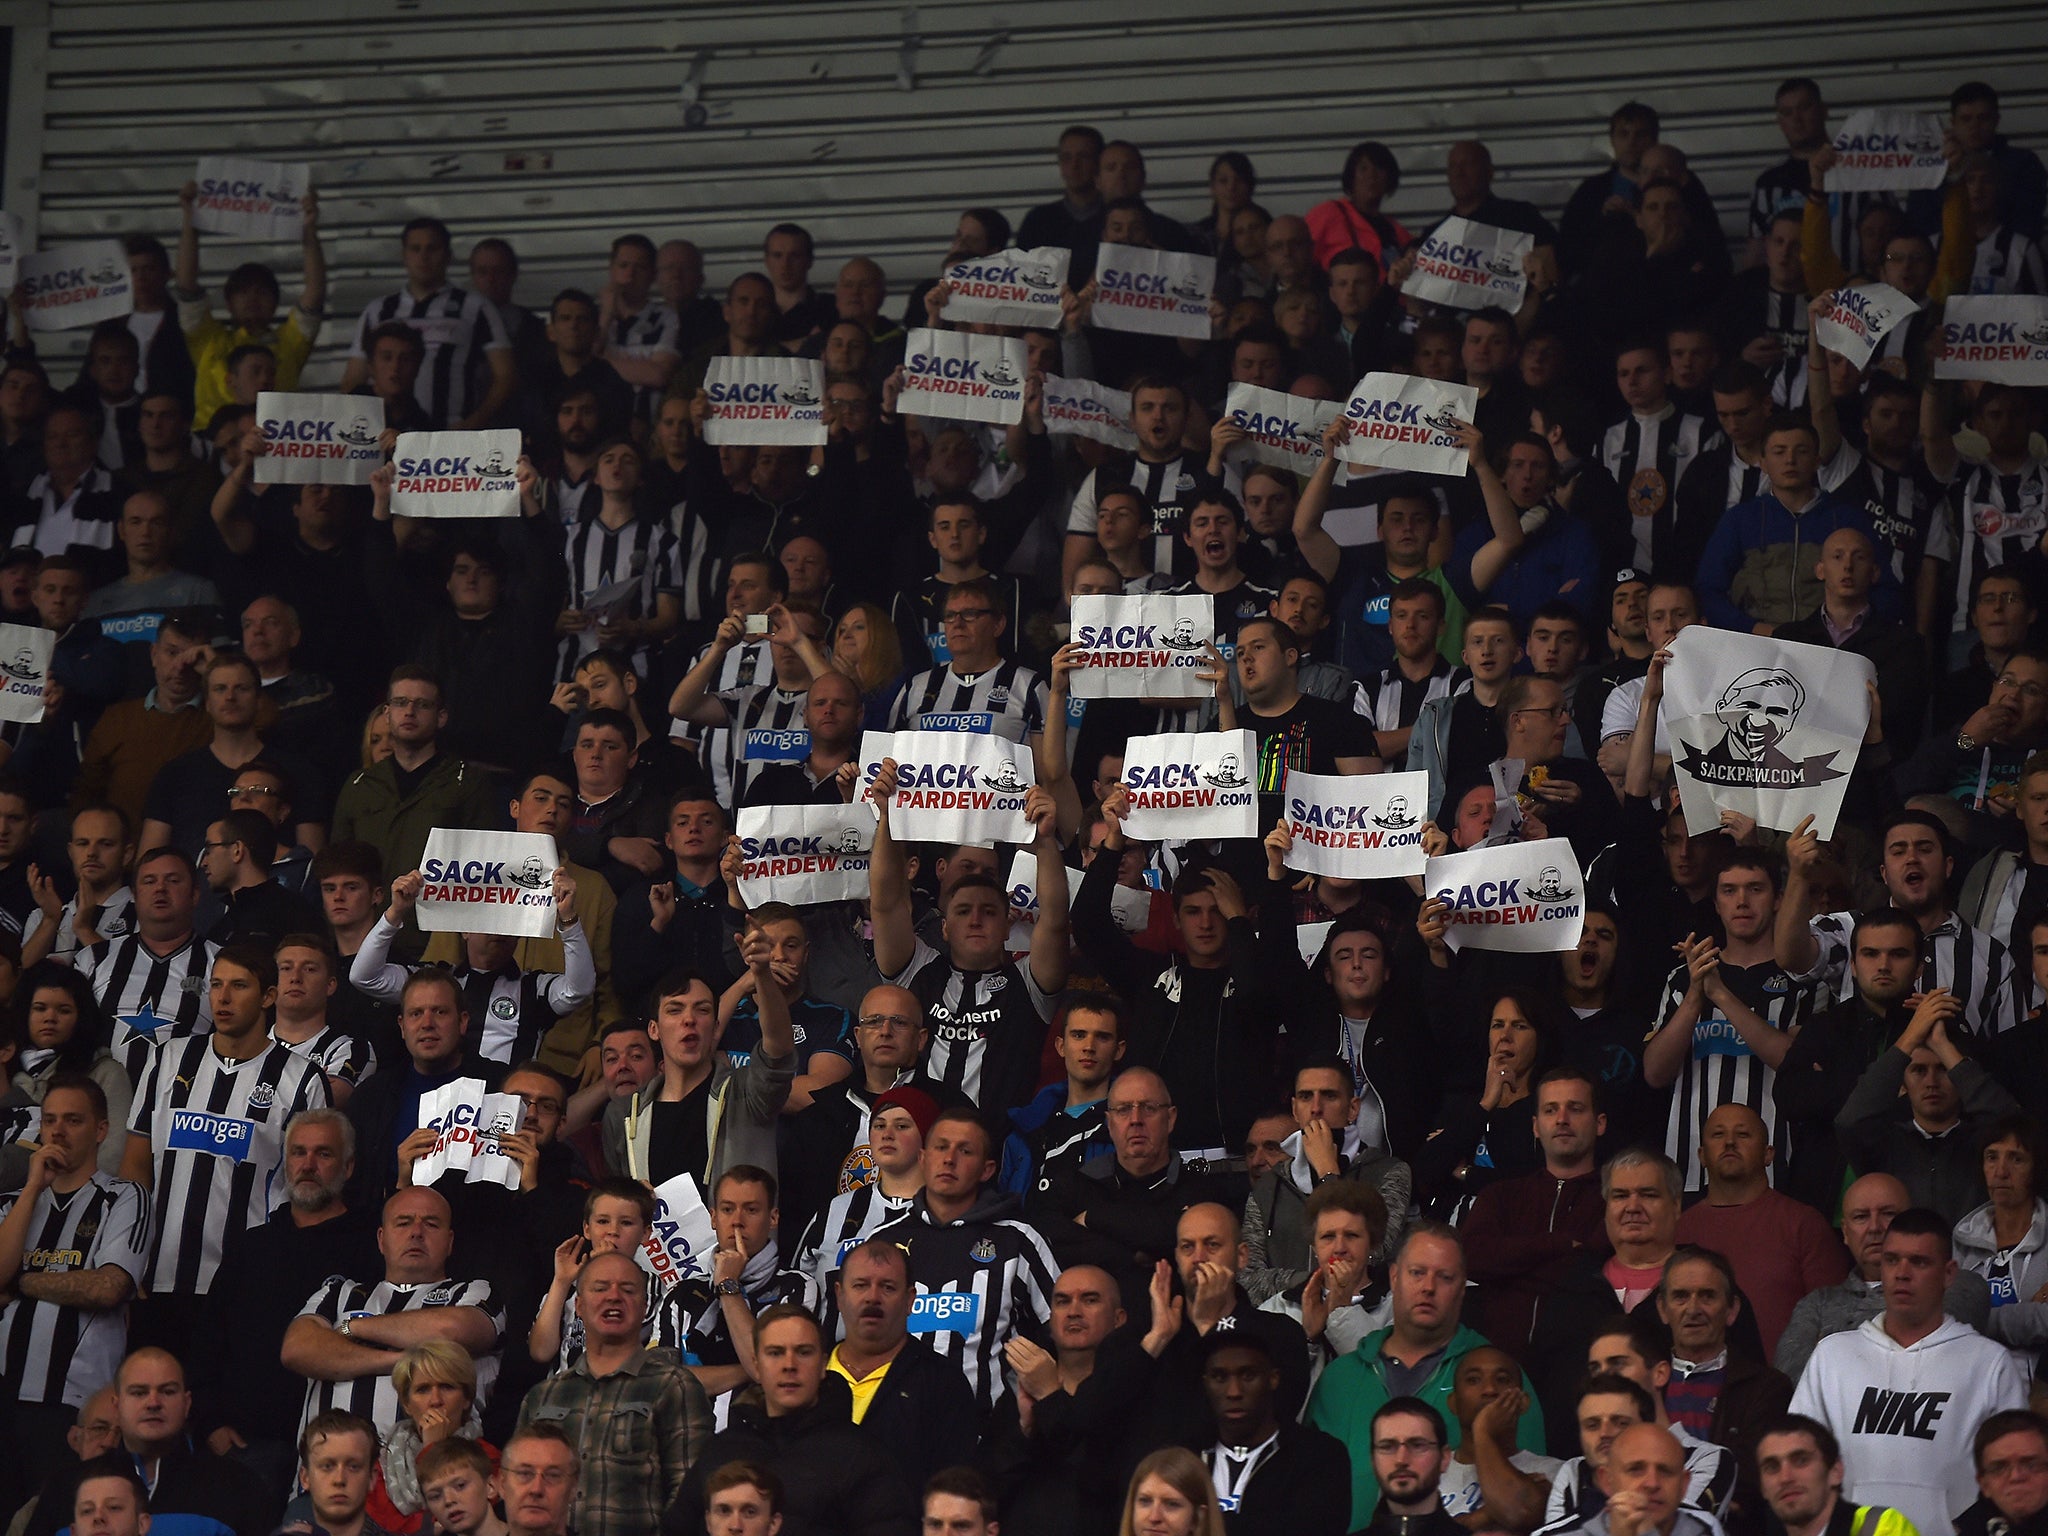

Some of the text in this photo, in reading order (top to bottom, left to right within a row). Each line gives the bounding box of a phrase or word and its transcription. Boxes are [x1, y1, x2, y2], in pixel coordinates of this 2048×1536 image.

[1834, 134, 1898, 152] SACK
[201, 178, 263, 199] SACK
[1421, 238, 1482, 268] SACK
[24, 267, 85, 296] SACK
[949, 264, 1019, 284] SACK
[1101, 269, 1167, 293] SACK
[1944, 322, 2018, 344] SACK
[908, 353, 979, 380] SACK
[710, 383, 779, 403] SACK
[1347, 398, 1423, 425] SACK
[263, 420, 334, 441] SACK
[1232, 409, 1300, 440] SACK
[398, 457, 471, 477] SACK
[1079, 624, 1157, 649] SACK
[920, 714, 982, 731] wonga
[748, 730, 803, 750] wonga
[896, 763, 979, 789] SACK
[1125, 763, 1201, 789] SACK
[1290, 797, 1370, 830] SACK
[741, 835, 823, 860] SACK
[423, 858, 504, 885] SACK
[1436, 878, 1521, 911] SACK
[937, 1024, 979, 1041] rock
[174, 1114, 241, 1144] wonga
[652, 1198, 704, 1279] SACK
[911, 1294, 966, 1319] onga
[1851, 1386, 1952, 1441] NIKE
